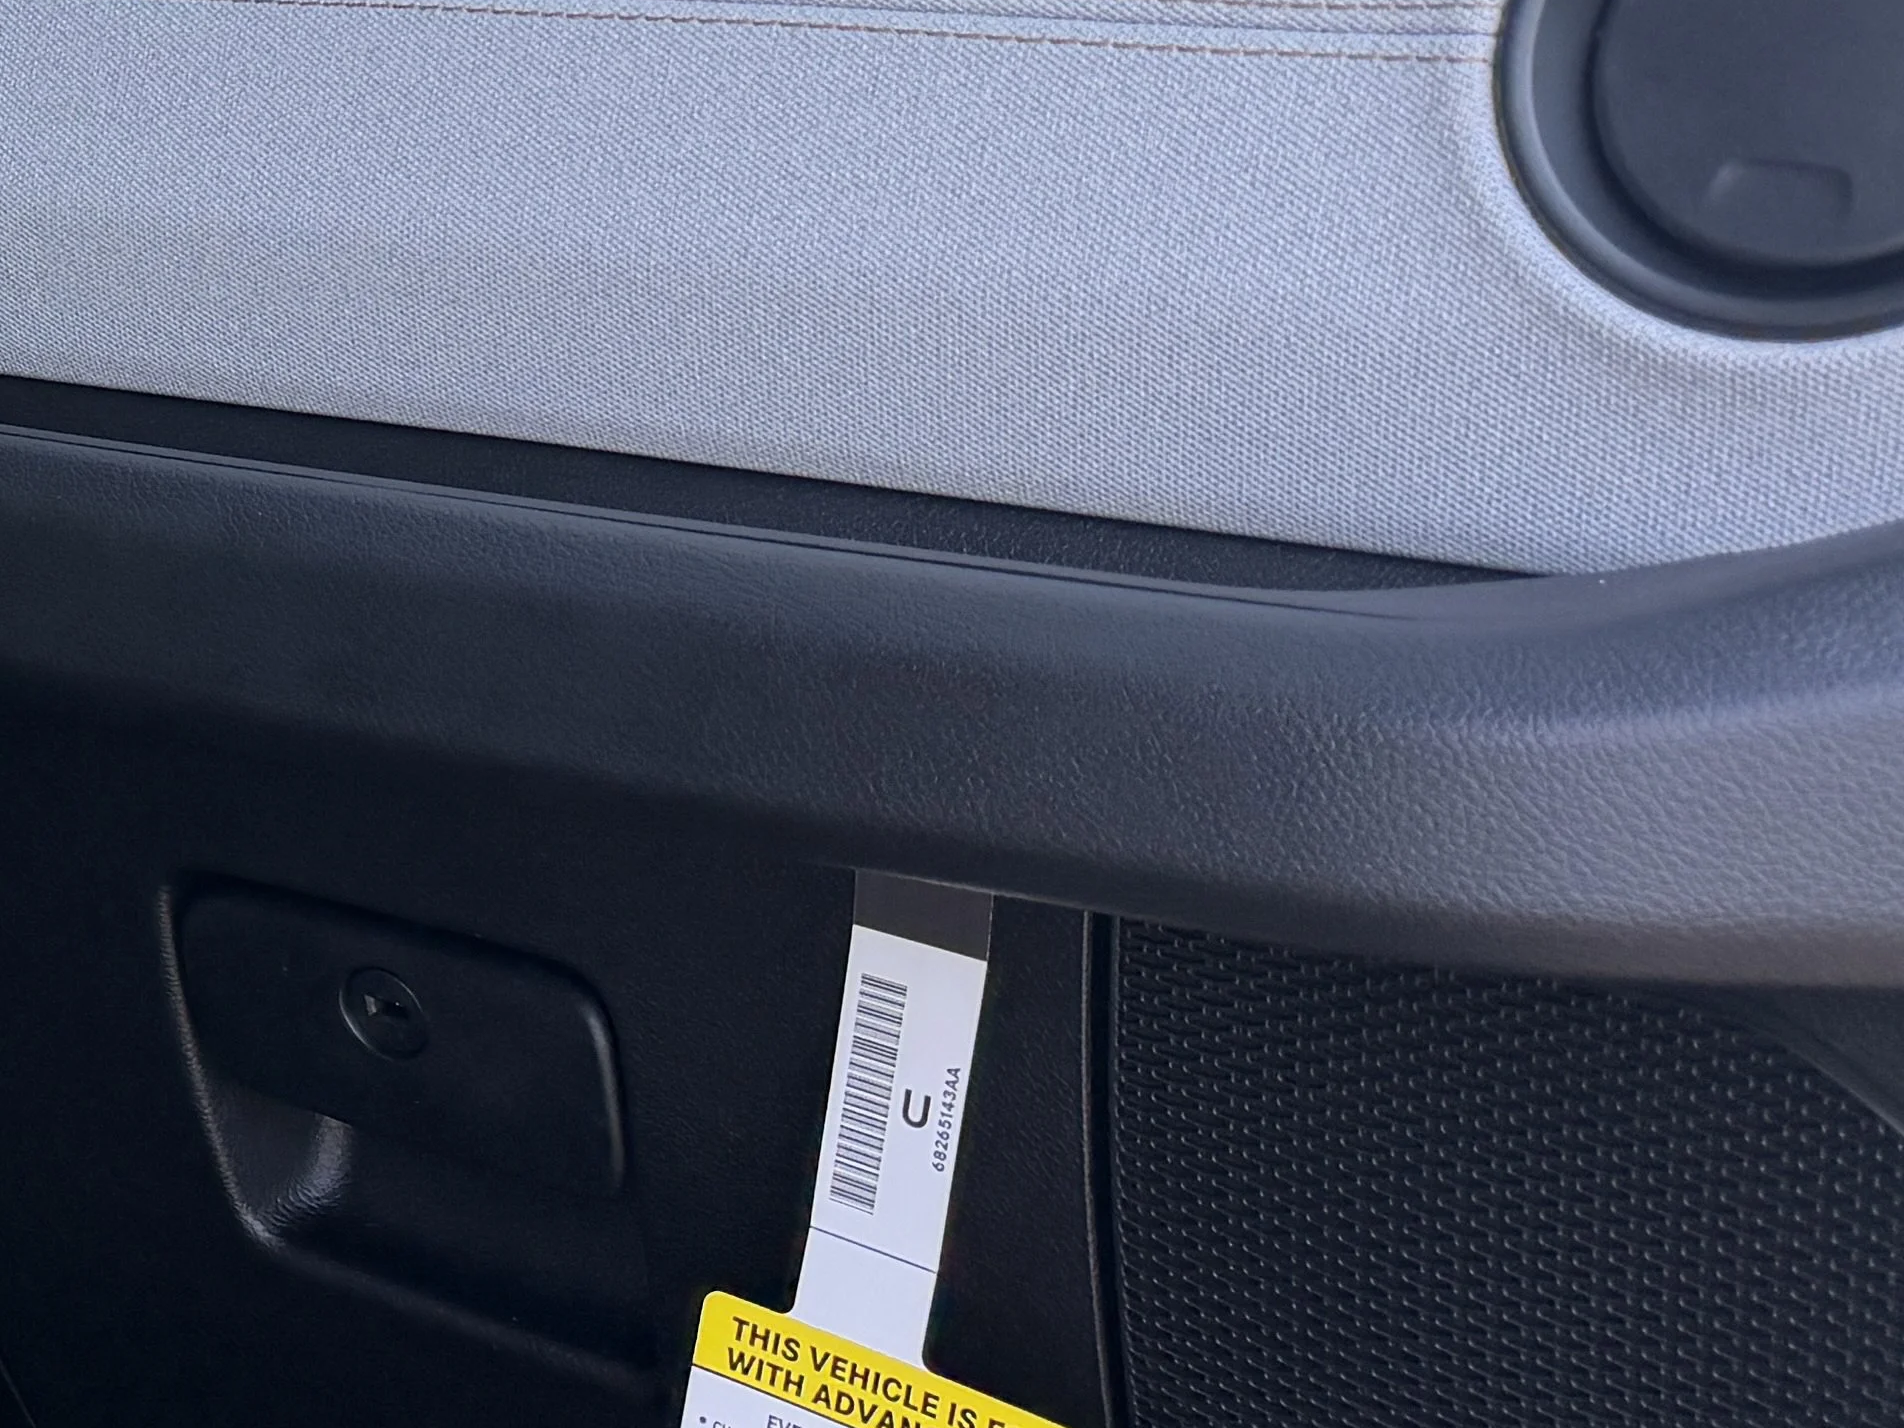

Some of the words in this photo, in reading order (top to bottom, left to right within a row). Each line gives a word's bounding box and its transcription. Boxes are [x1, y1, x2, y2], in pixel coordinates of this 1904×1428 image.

[902, 1088, 932, 1129] U
[931, 1067, 961, 1173] 68265143AA
[728, 1347, 805, 1397] WITH
[732, 1316, 801, 1362] THIS
[810, 1346, 940, 1419] VEHICLE
